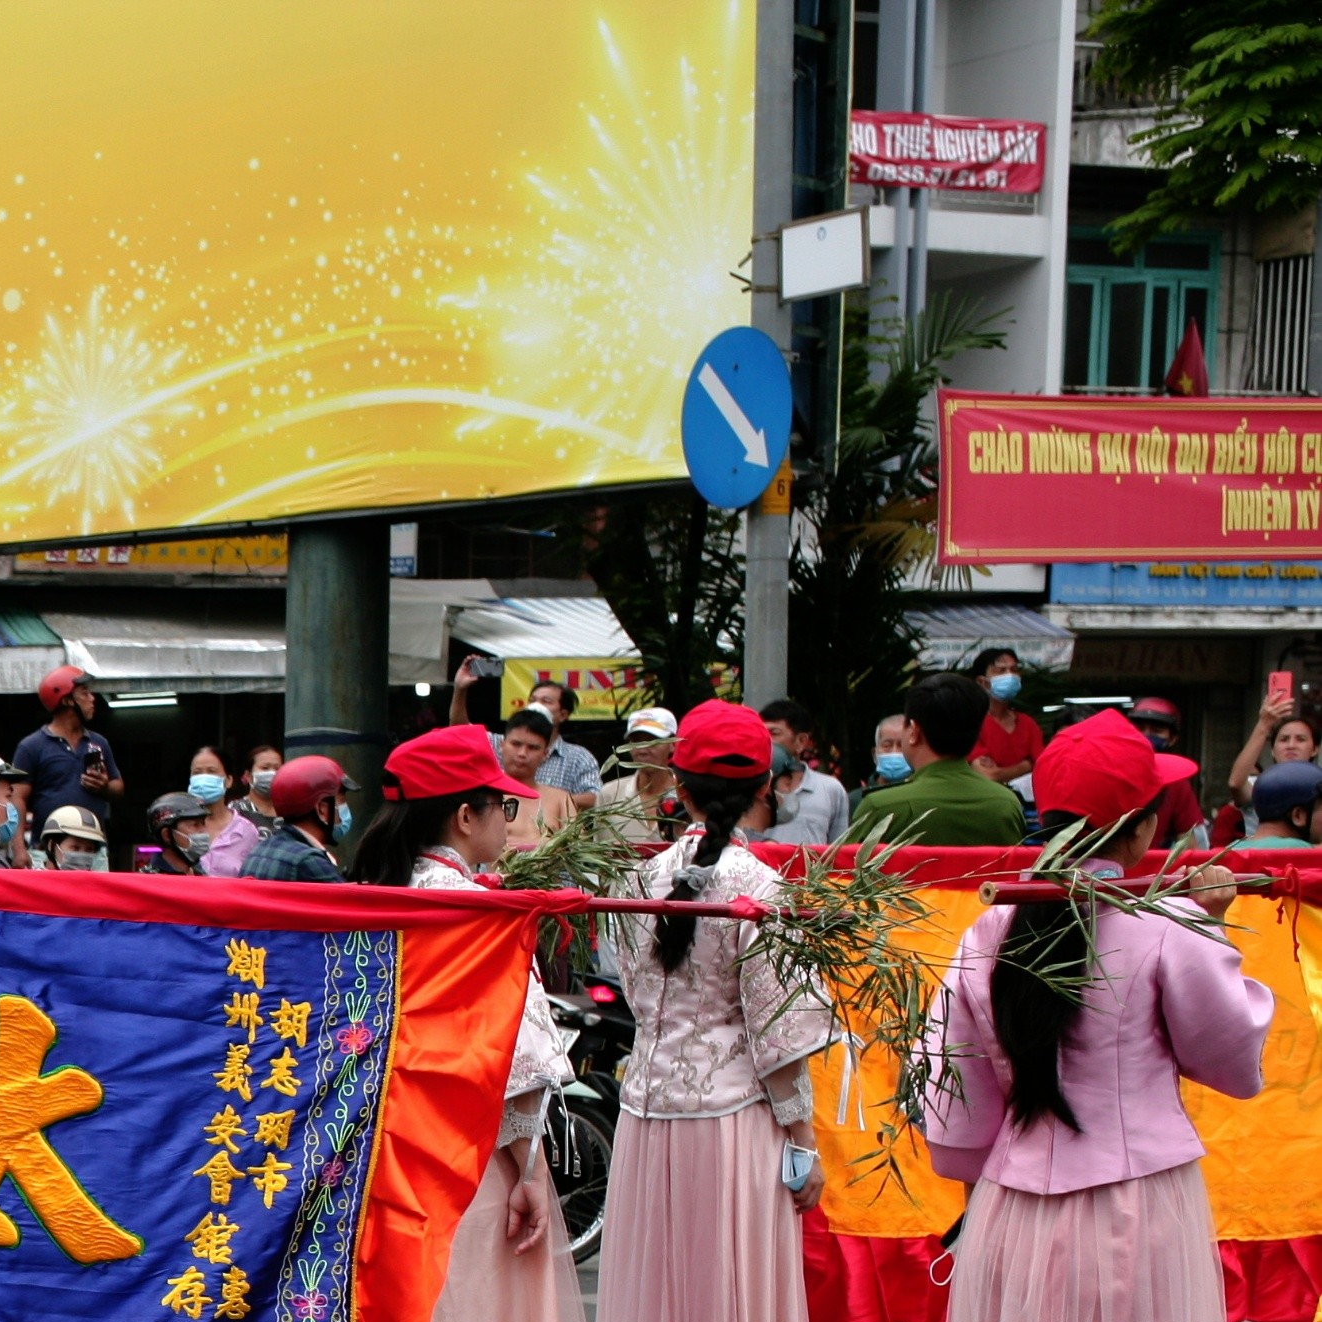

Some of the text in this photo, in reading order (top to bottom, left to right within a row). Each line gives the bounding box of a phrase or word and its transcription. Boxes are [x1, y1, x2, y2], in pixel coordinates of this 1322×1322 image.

[850, 123, 878, 156] HO
[883, 119, 932, 160] THUÊ
[968, 424, 1023, 474] CHÀO
[1028, 425, 1092, 474] MỪNG
[1098, 432, 1131, 484] ĐẠI
[1135, 426, 1170, 484] HỘI
[1175, 432, 1208, 484] ĐẠI
[1213, 417, 1257, 474] BIỂU
[1262, 426, 1297, 484] HỘI
